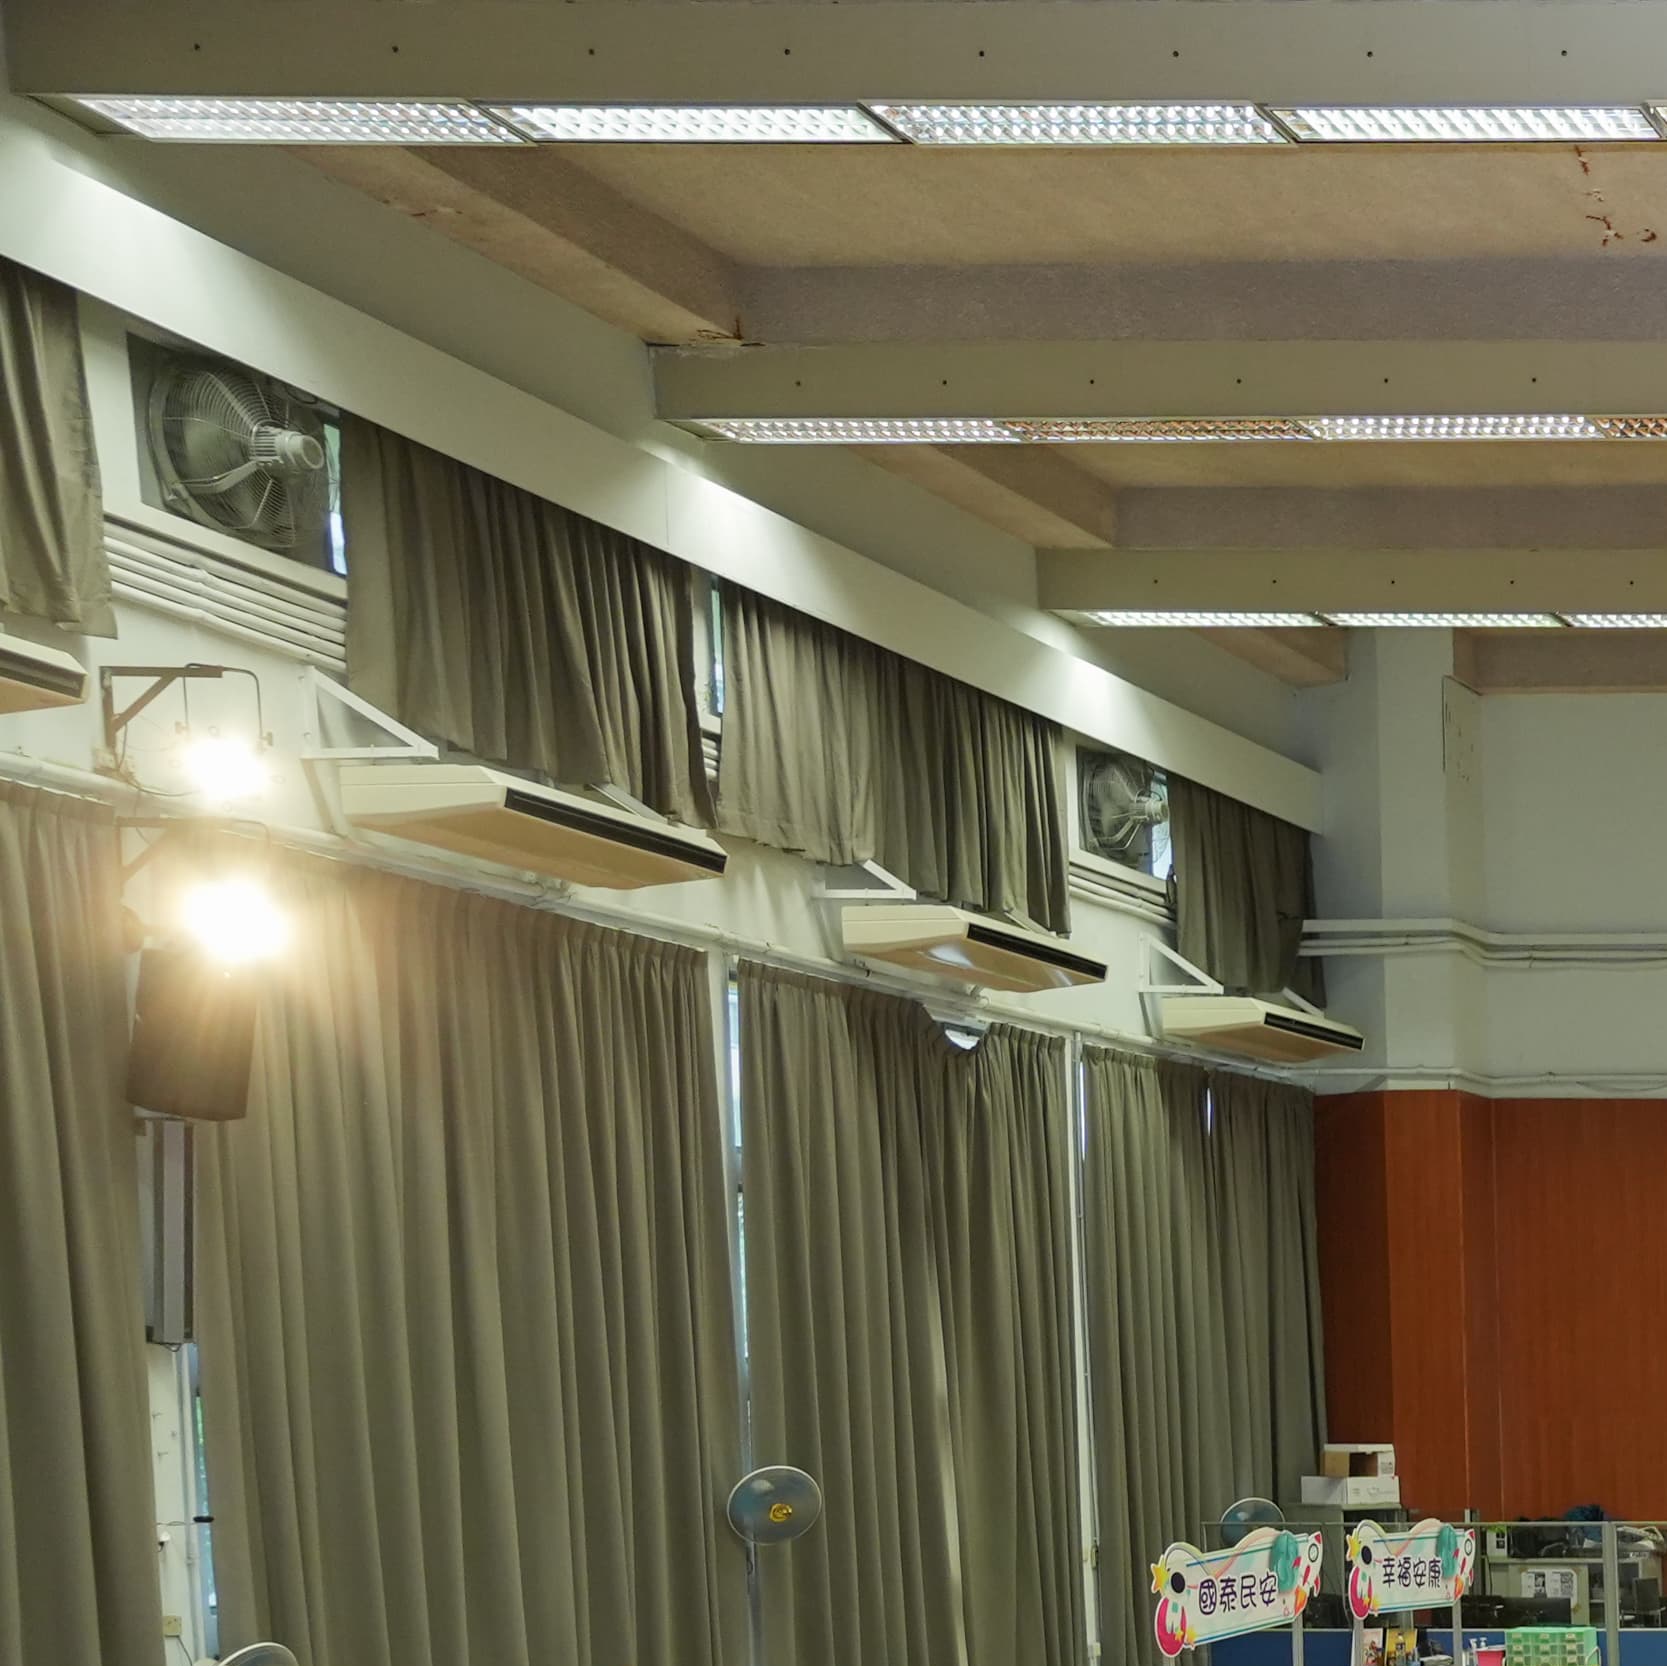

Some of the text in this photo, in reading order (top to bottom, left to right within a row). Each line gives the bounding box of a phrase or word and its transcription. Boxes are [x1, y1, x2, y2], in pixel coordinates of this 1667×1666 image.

[1382, 1556, 1442, 1589] 幸福安康
[1199, 1571, 1278, 1615] 國泰民安
